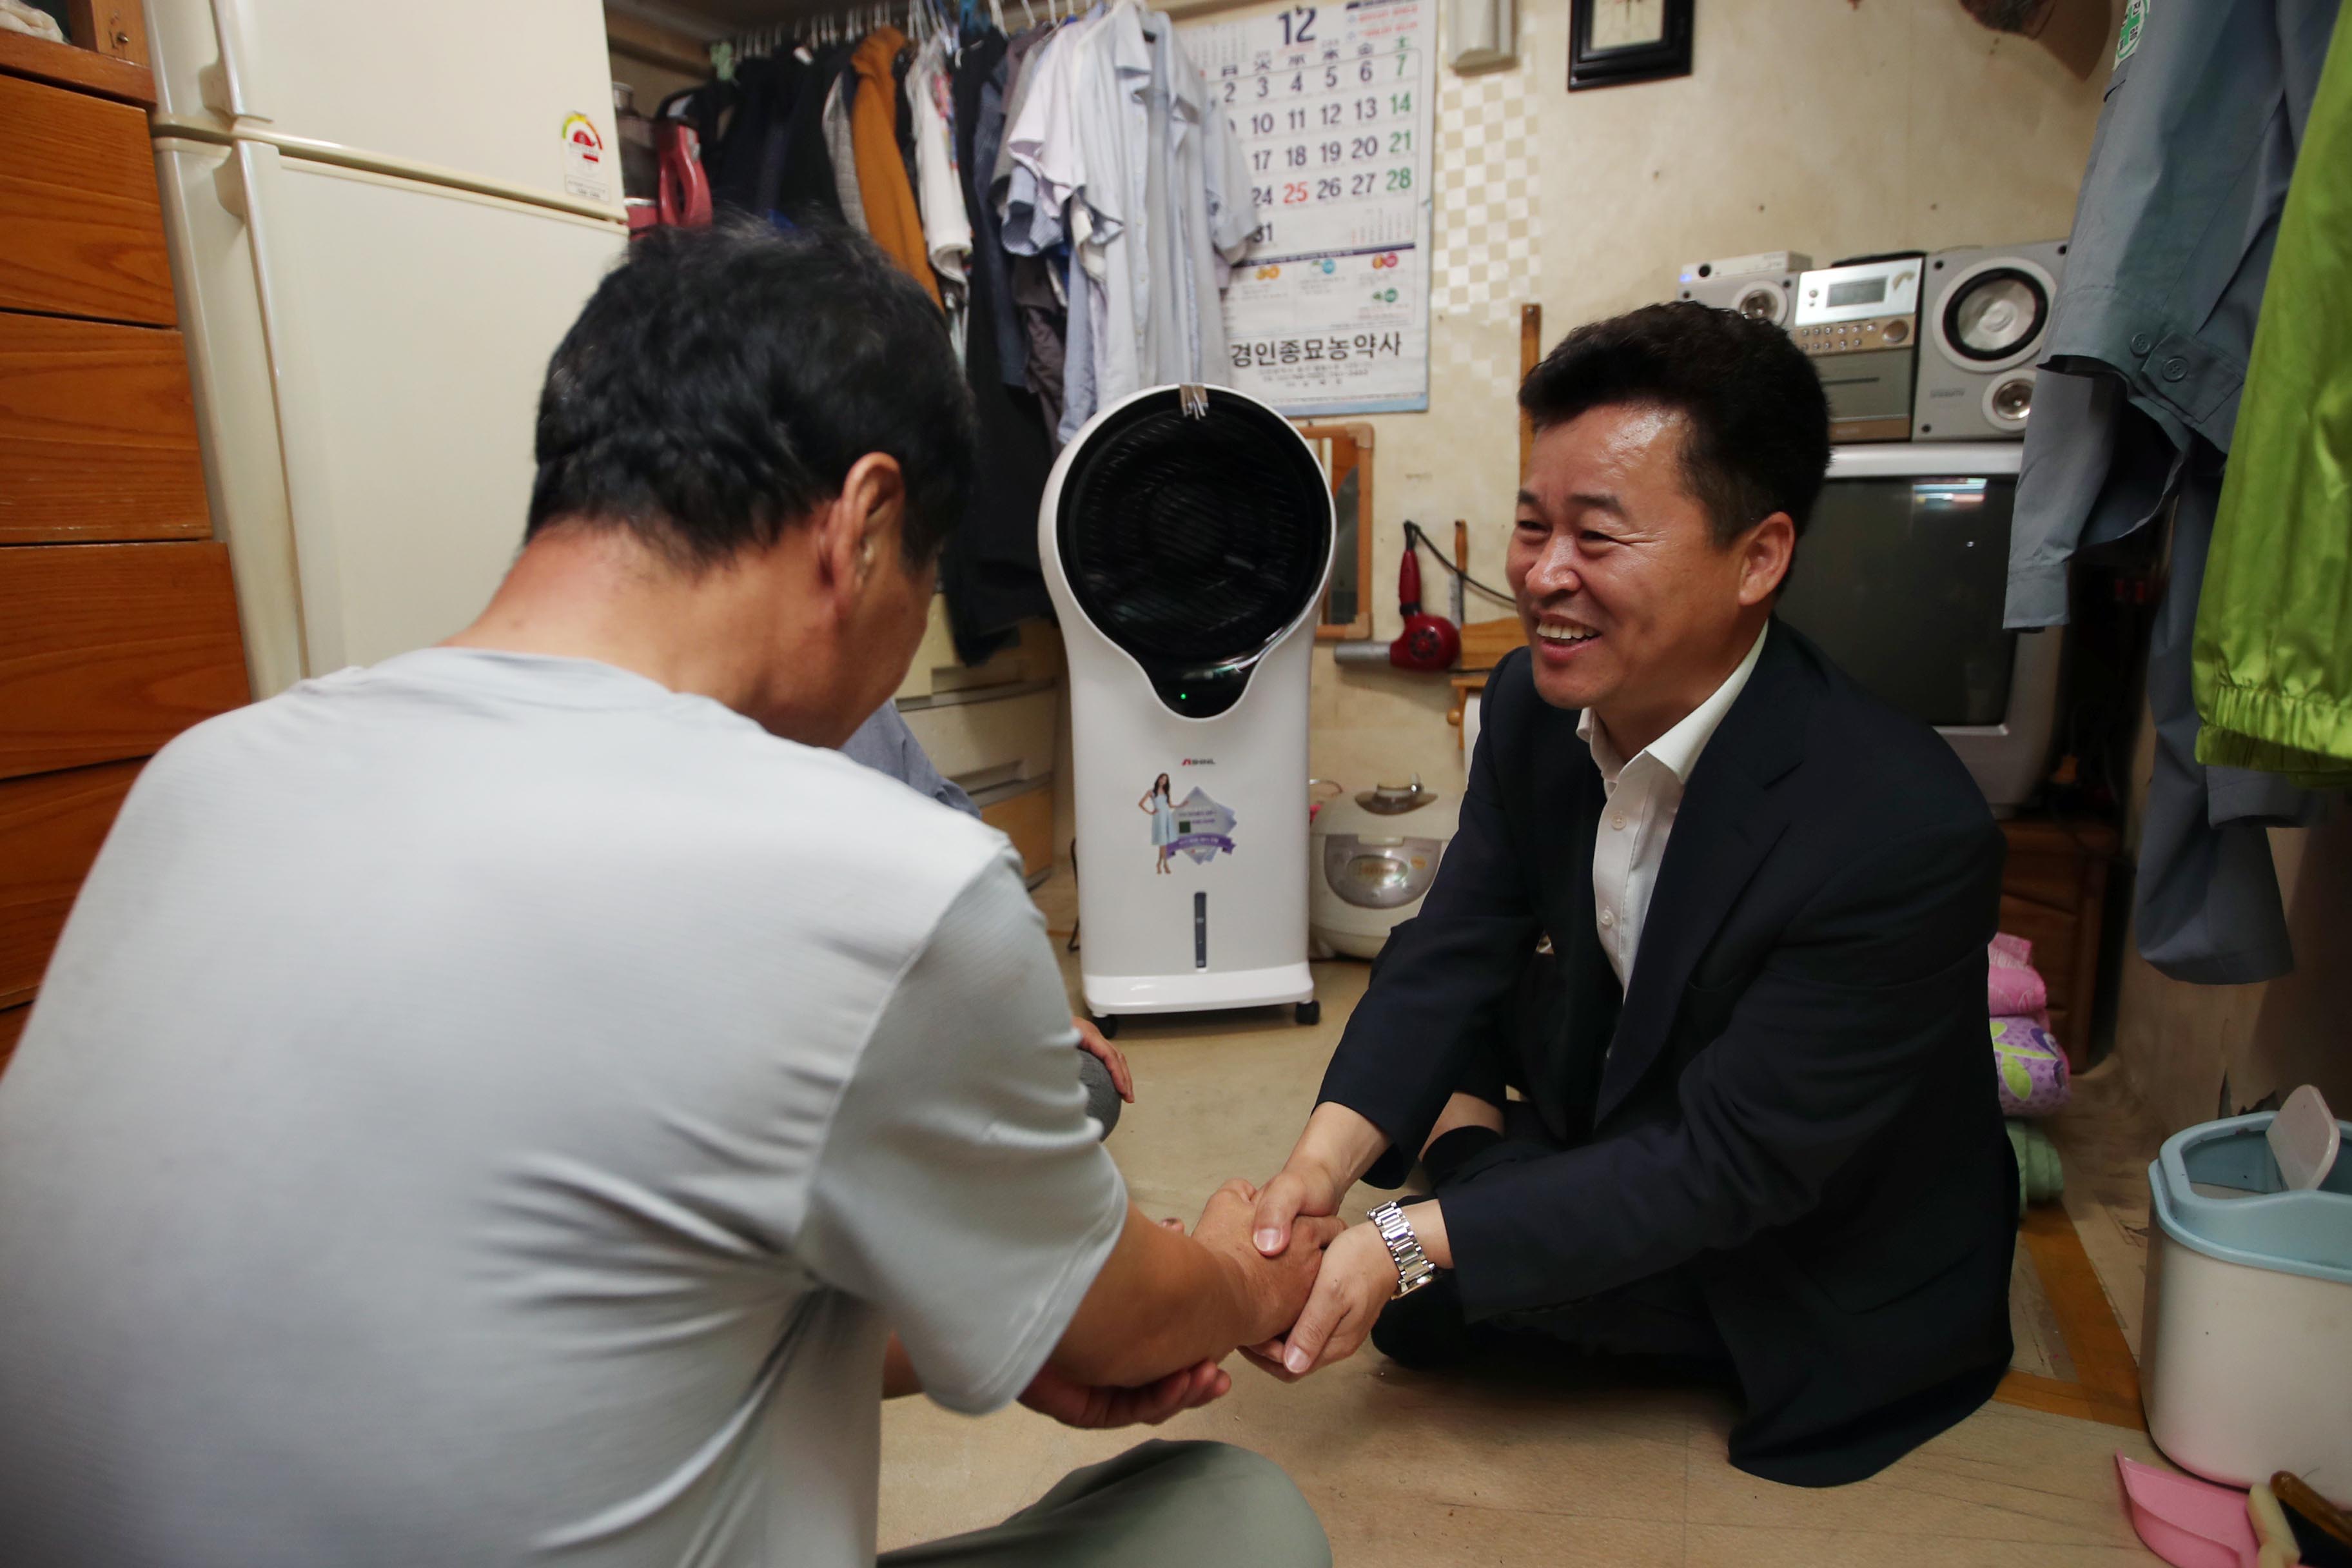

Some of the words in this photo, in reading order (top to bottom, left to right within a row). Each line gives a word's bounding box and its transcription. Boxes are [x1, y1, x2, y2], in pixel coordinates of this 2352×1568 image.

[1279, 6, 1316, 46] 12
[1225, 81, 1236, 103] 2
[1257, 76, 1269, 98] 3
[1291, 71, 1302, 92] 4
[1326, 65, 1337, 88] 5
[1360, 60, 1373, 82] 6
[1396, 54, 1407, 76] 7
[1251, 112, 1274, 134] 10
[1288, 108, 1305, 130] 11
[1320, 103, 1342, 125] 12
[1355, 97, 1377, 121] 13
[1389, 91, 1411, 115] 14
[1253, 149, 1272, 170] 17
[1286, 144, 1307, 167] 18
[1320, 141, 1342, 162] 19
[1351, 135, 1378, 159] 20
[1389, 130, 1411, 153] 21
[1251, 185, 1273, 208] 24
[1283, 181, 1309, 204] 25
[1317, 177, 1342, 200] 26
[1351, 172, 1377, 195] 27
[1387, 166, 1412, 191] 28
[1231, 331, 1402, 368] 경인종묘농약사
